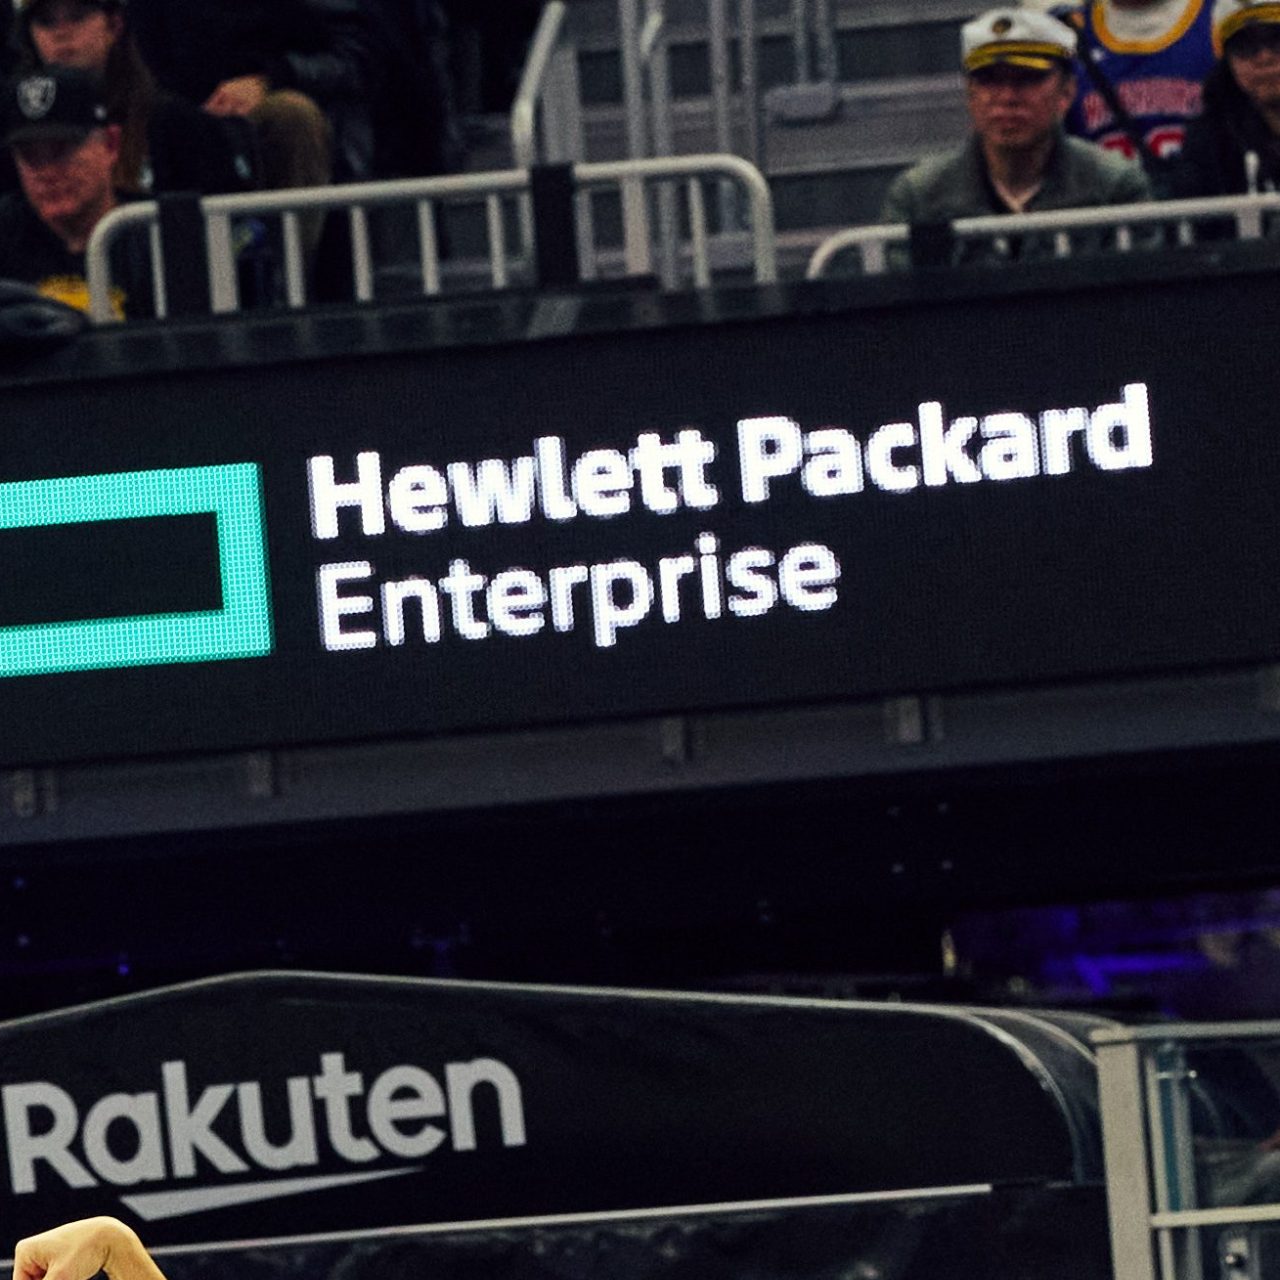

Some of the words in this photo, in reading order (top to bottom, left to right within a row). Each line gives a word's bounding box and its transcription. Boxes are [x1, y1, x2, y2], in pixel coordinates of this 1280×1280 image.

[307, 429, 720, 539] Hewlett
[737, 382, 1154, 504] Packard
[316, 532, 842, 652] Enterprise
[1, 1051, 527, 1195] Rakuten
